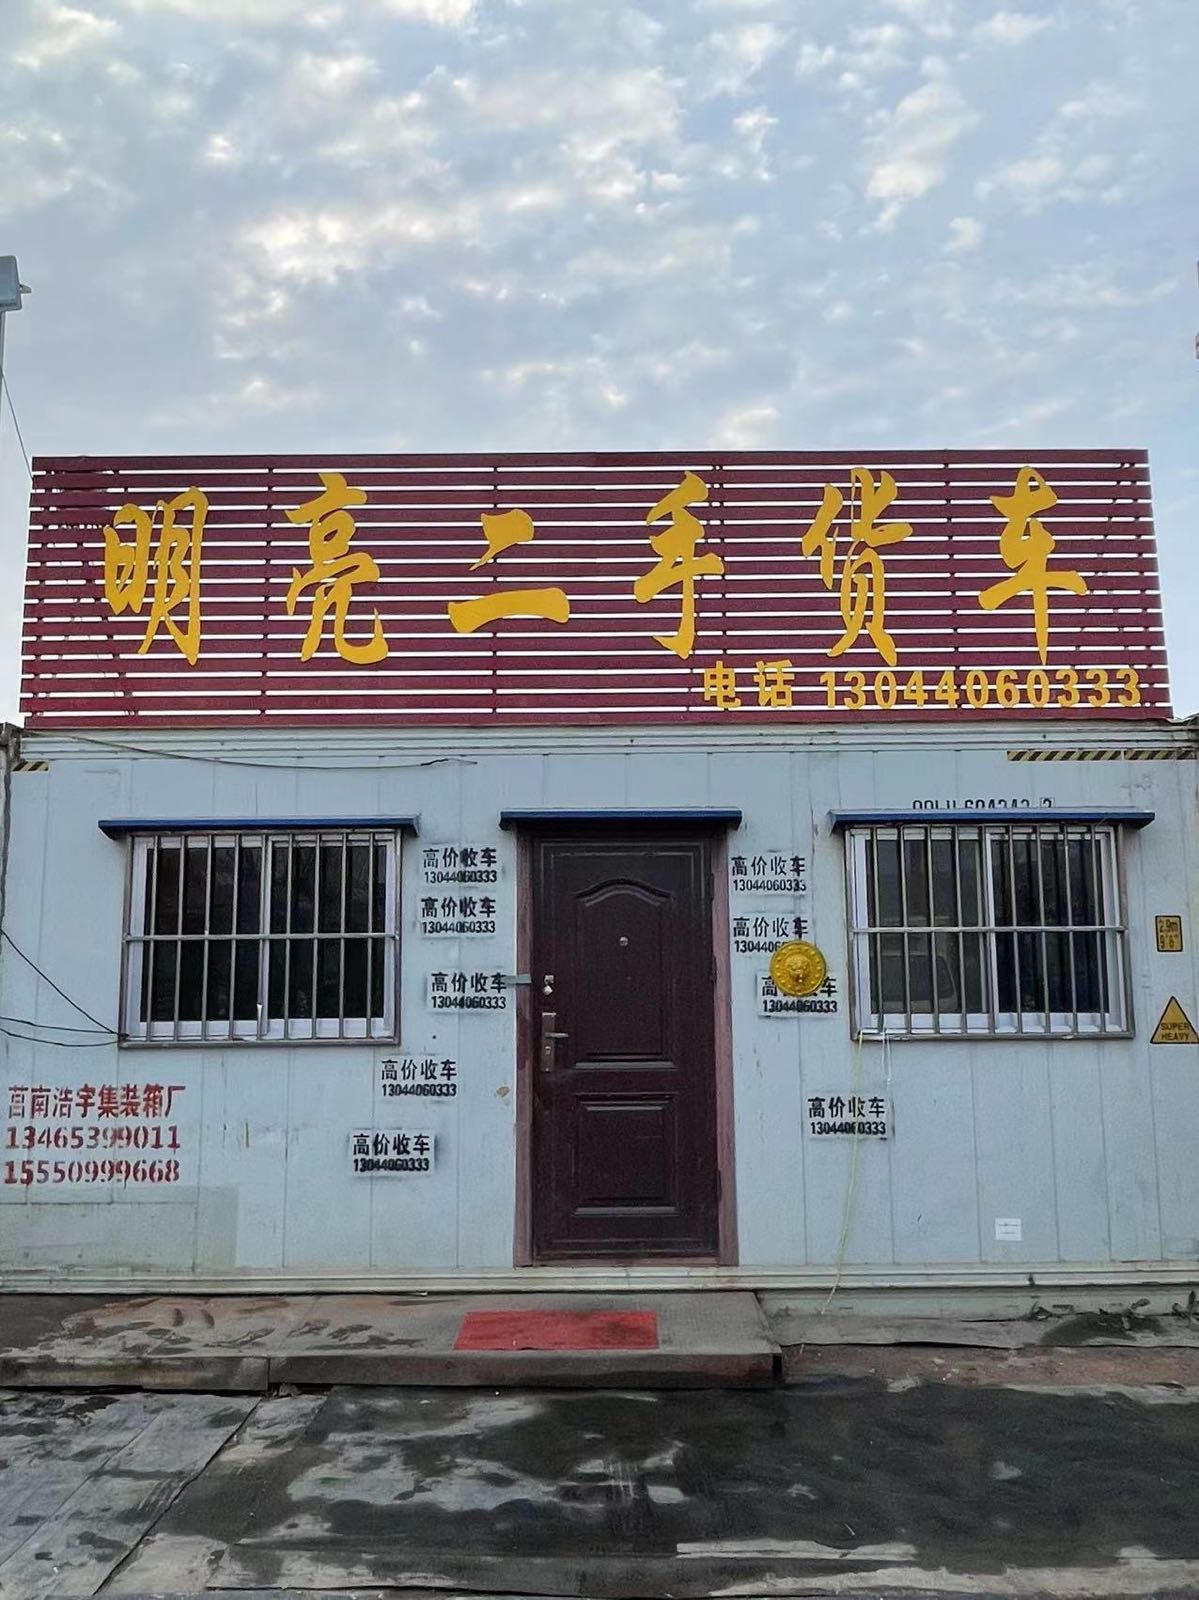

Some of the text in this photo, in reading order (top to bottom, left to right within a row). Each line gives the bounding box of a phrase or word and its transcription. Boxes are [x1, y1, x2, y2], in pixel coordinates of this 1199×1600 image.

[104, 466, 1088, 666] 明亮二手货车
[703, 660, 1141, 710] 电话 13044060333
[423, 847, 497, 868] 高价收车
[731, 856, 806, 877] 高价收车
[424, 870, 497, 883] 13044060333
[733, 879, 807, 892] 13044060333
[421, 896, 496, 918] 高价收车
[422, 921, 496, 934] 13044060333
[733, 917, 809, 939] 高价收车
[431, 972, 507, 993] 高价收车
[761, 976, 837, 998] 高车
[431, 996, 506, 1009] 13044060333
[762, 1000, 838, 1013] 13044060333
[1161, 1022, 1190, 1030] SUPER
[1161, 1032, 1190, 1041] HEAVY
[381, 1059, 457, 1081] 高价收车
[382, 1083, 457, 1096] 13044060333
[808, 1096, 885, 1118] 高价收车
[5, 1125, 181, 1149] 13465399011
[810, 1121, 886, 1135] 13044060333
[353, 1133, 430, 1156] 高价收车
[5, 1159, 181, 1185] 15550999668
[353, 1158, 430, 1172] 13044060333
